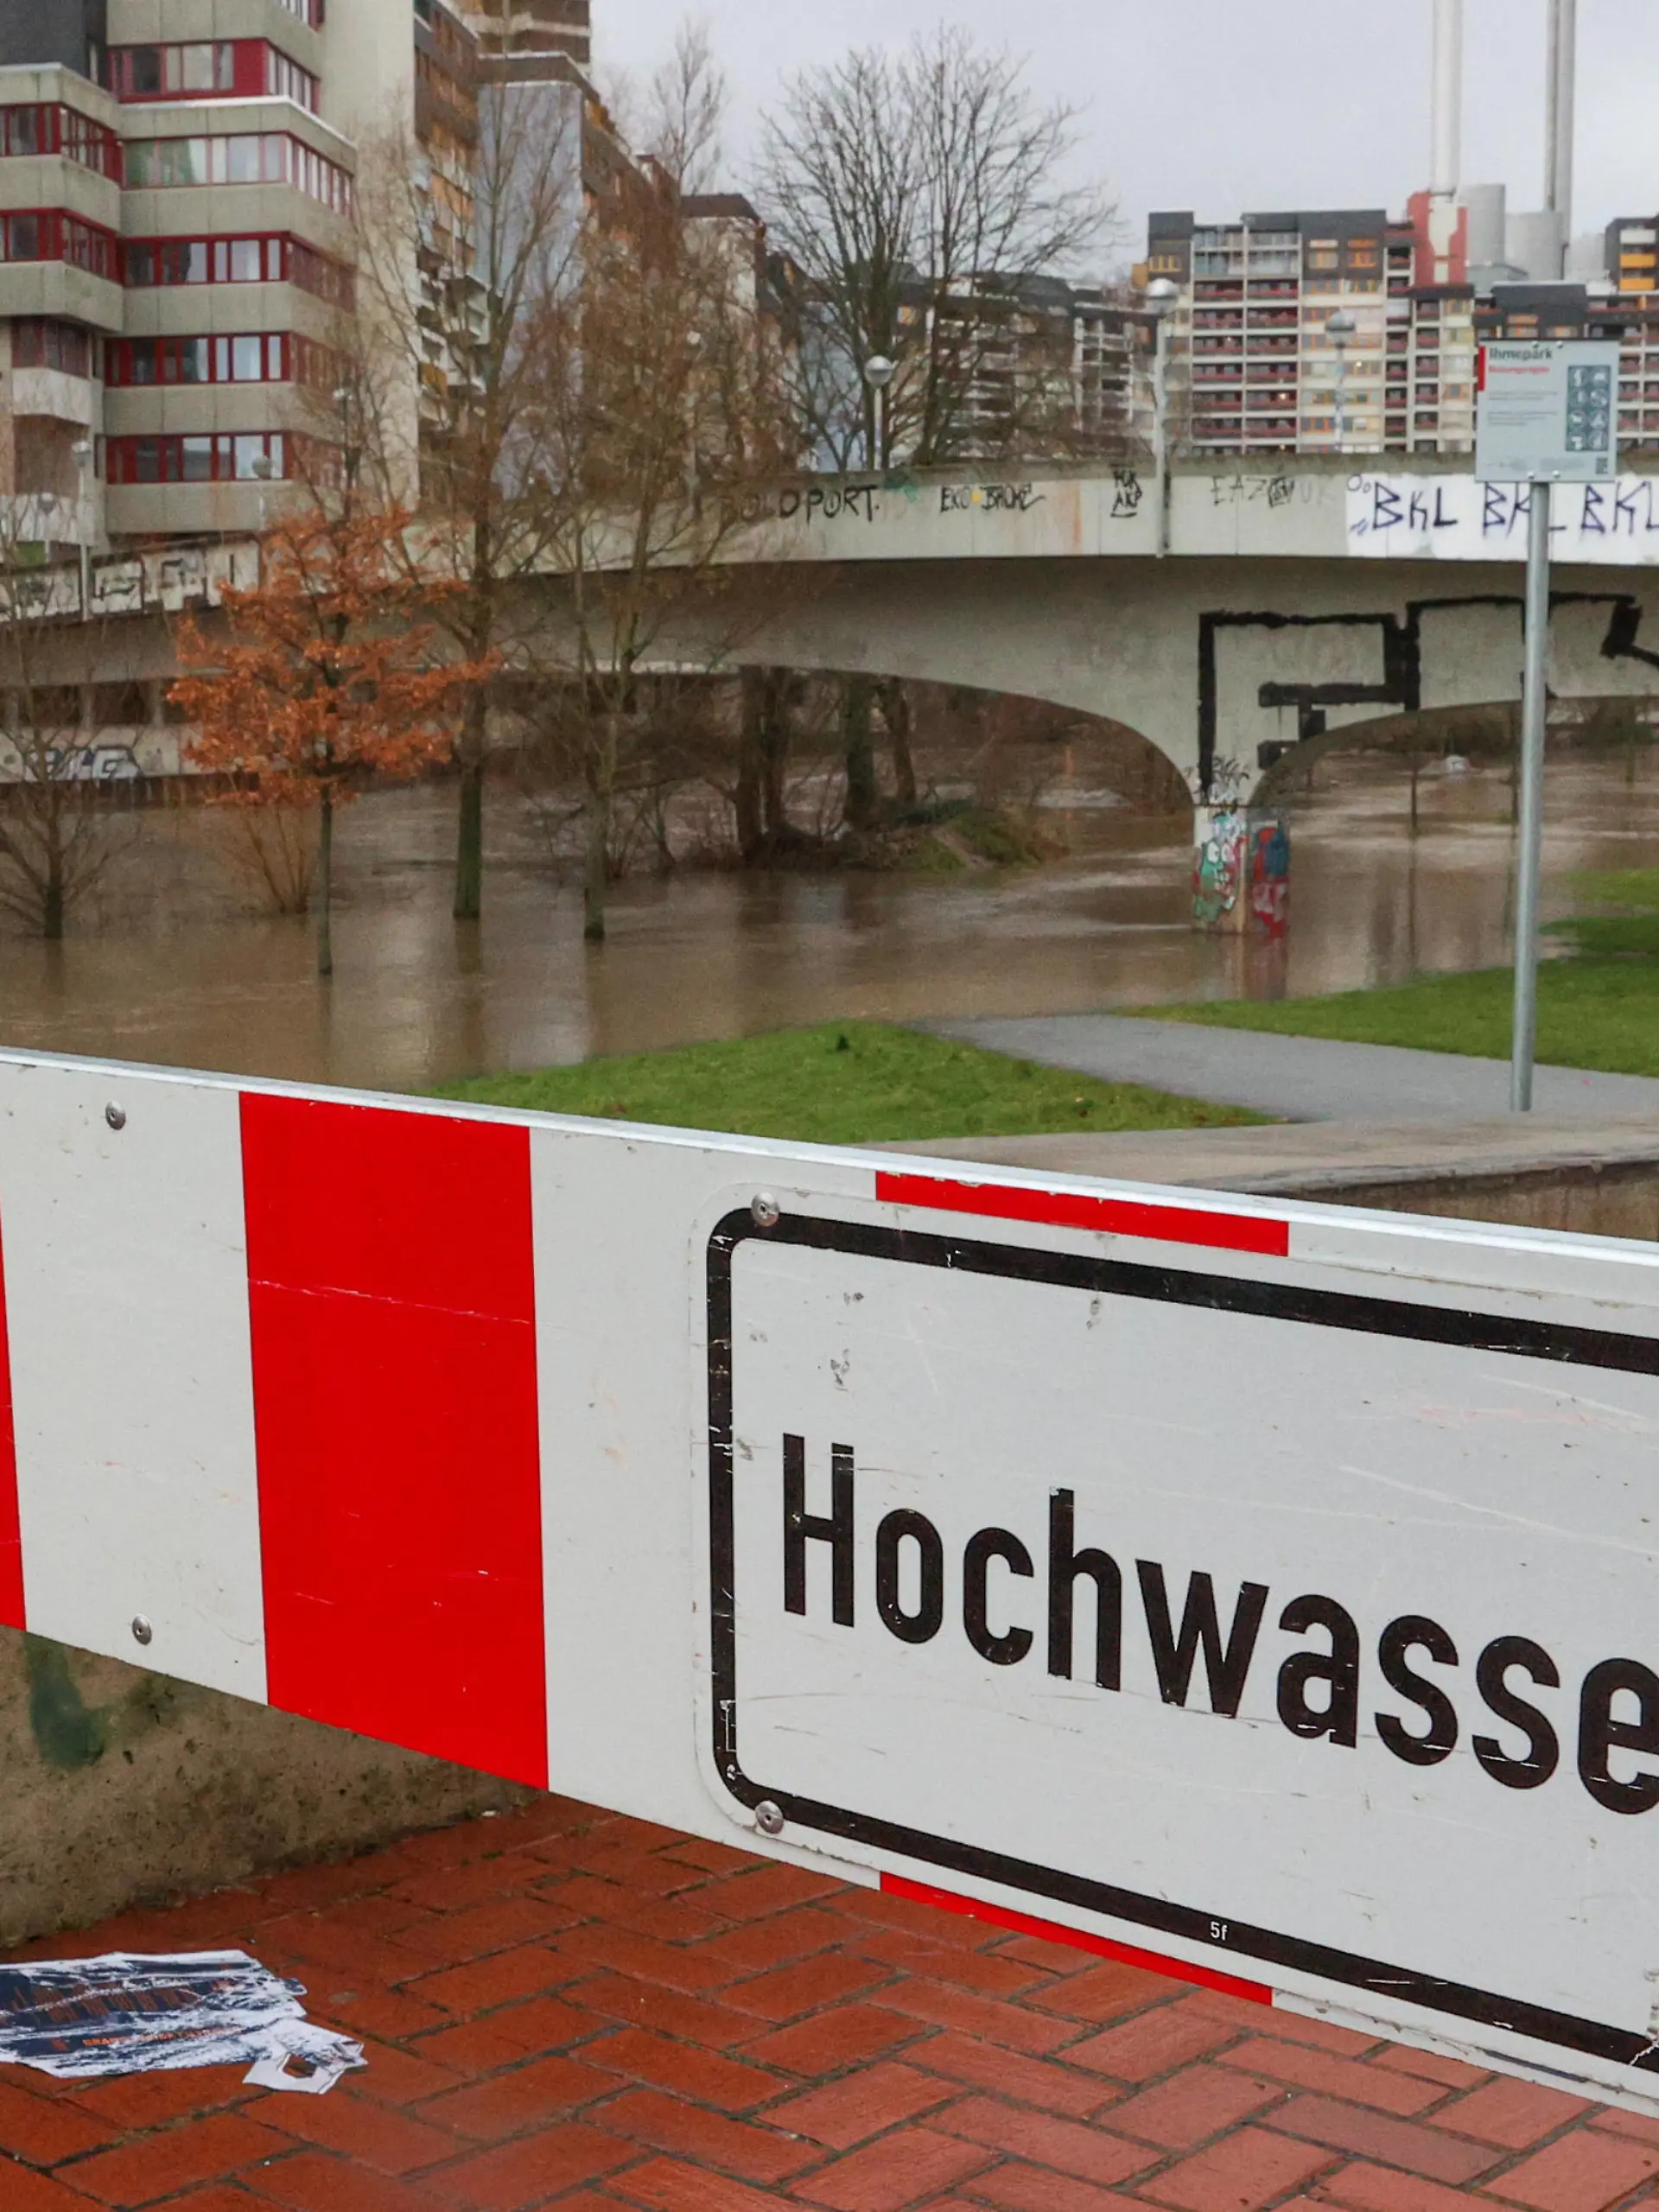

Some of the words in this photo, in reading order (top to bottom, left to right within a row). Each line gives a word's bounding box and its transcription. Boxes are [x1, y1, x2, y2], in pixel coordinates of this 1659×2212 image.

[1372, 481, 1458, 531] BKL
[1483, 482, 1567, 537] BK
[783, 1433, 1659, 1815] Hochwasse
[1210, 1921, 1229, 1942] 5f
